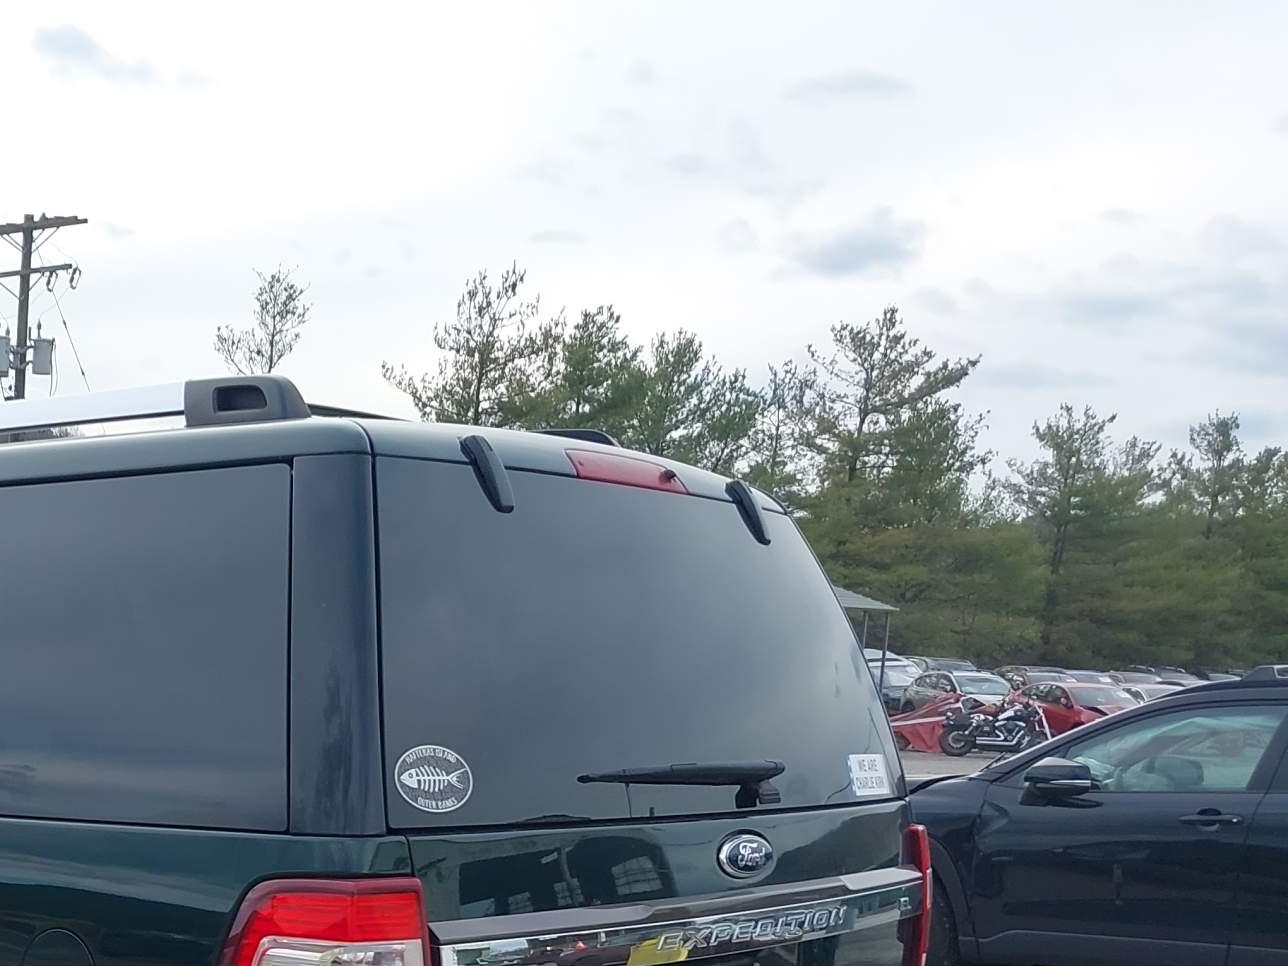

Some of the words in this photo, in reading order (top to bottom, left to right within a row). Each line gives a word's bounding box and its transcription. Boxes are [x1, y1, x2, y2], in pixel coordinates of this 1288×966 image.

[417, 796, 437, 809] OUTER
[737, 842, 766, 867] Ford
[656, 904, 847, 951] EXPEDITION
